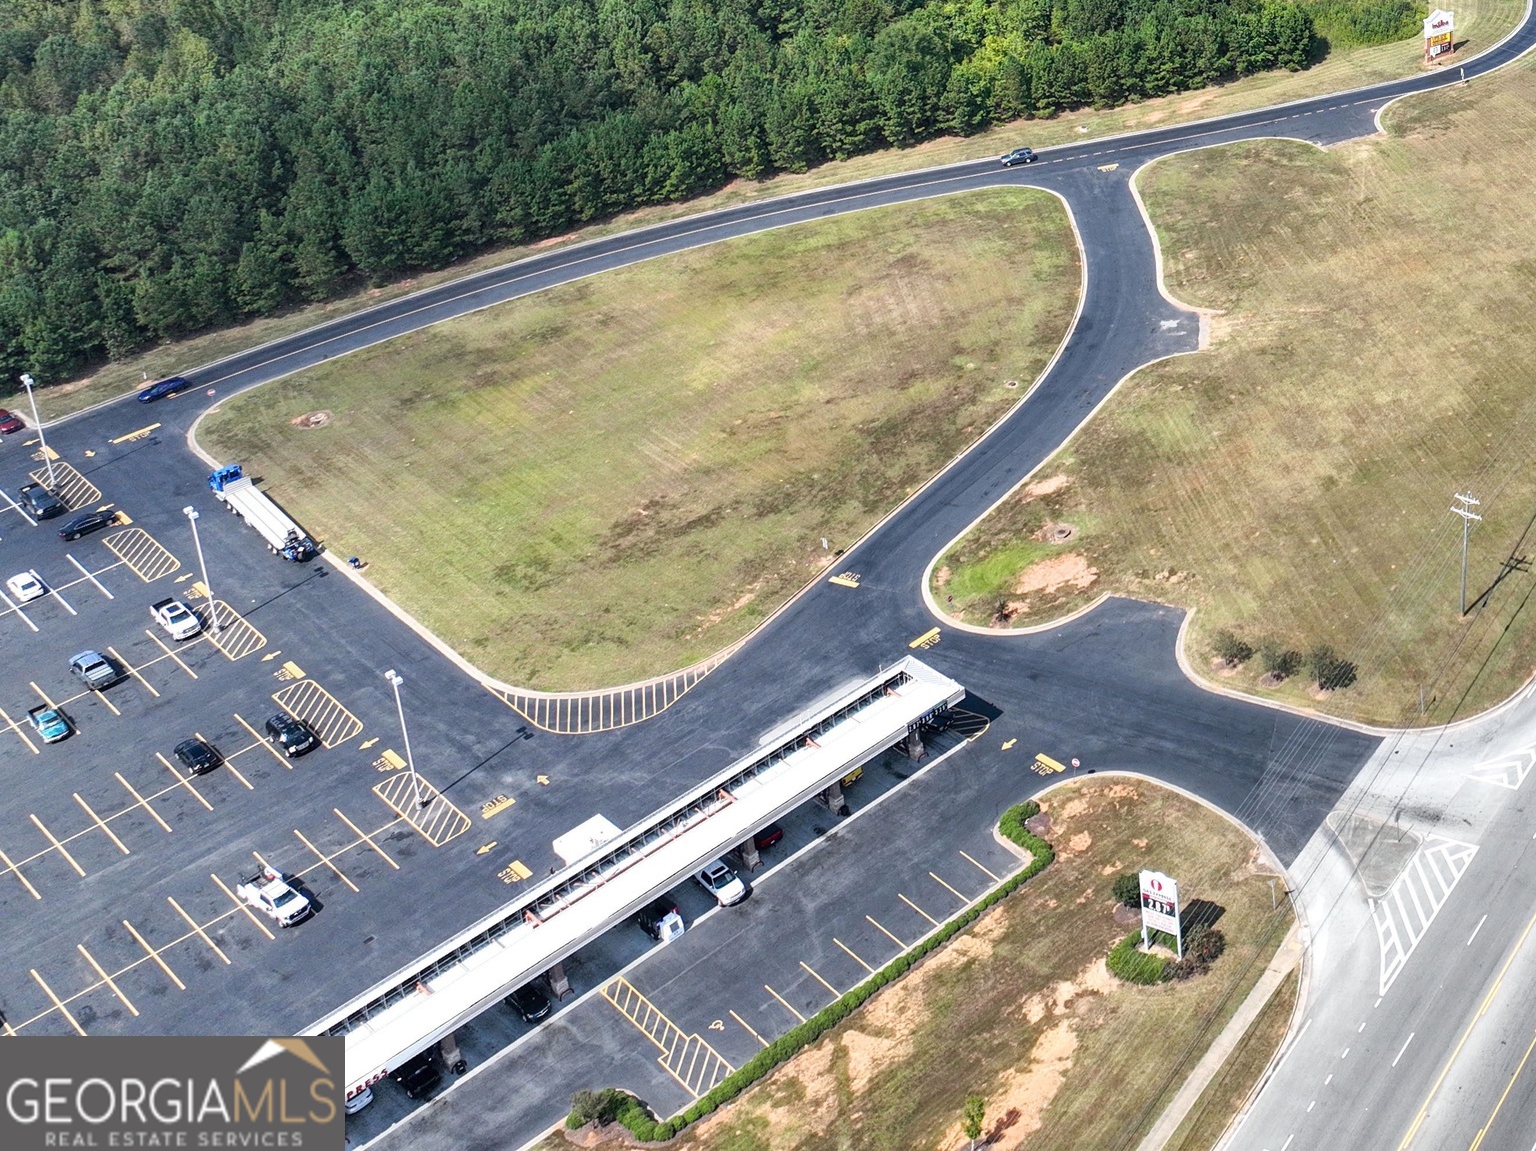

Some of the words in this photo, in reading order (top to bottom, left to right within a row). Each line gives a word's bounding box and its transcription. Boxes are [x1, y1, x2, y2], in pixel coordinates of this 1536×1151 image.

[920, 634, 941, 650] STOP
[372, 757, 395, 772] STOP
[1030, 761, 1054, 777] STOP
[482, 794, 508, 813] STOP
[497, 868, 522, 884] STOP
